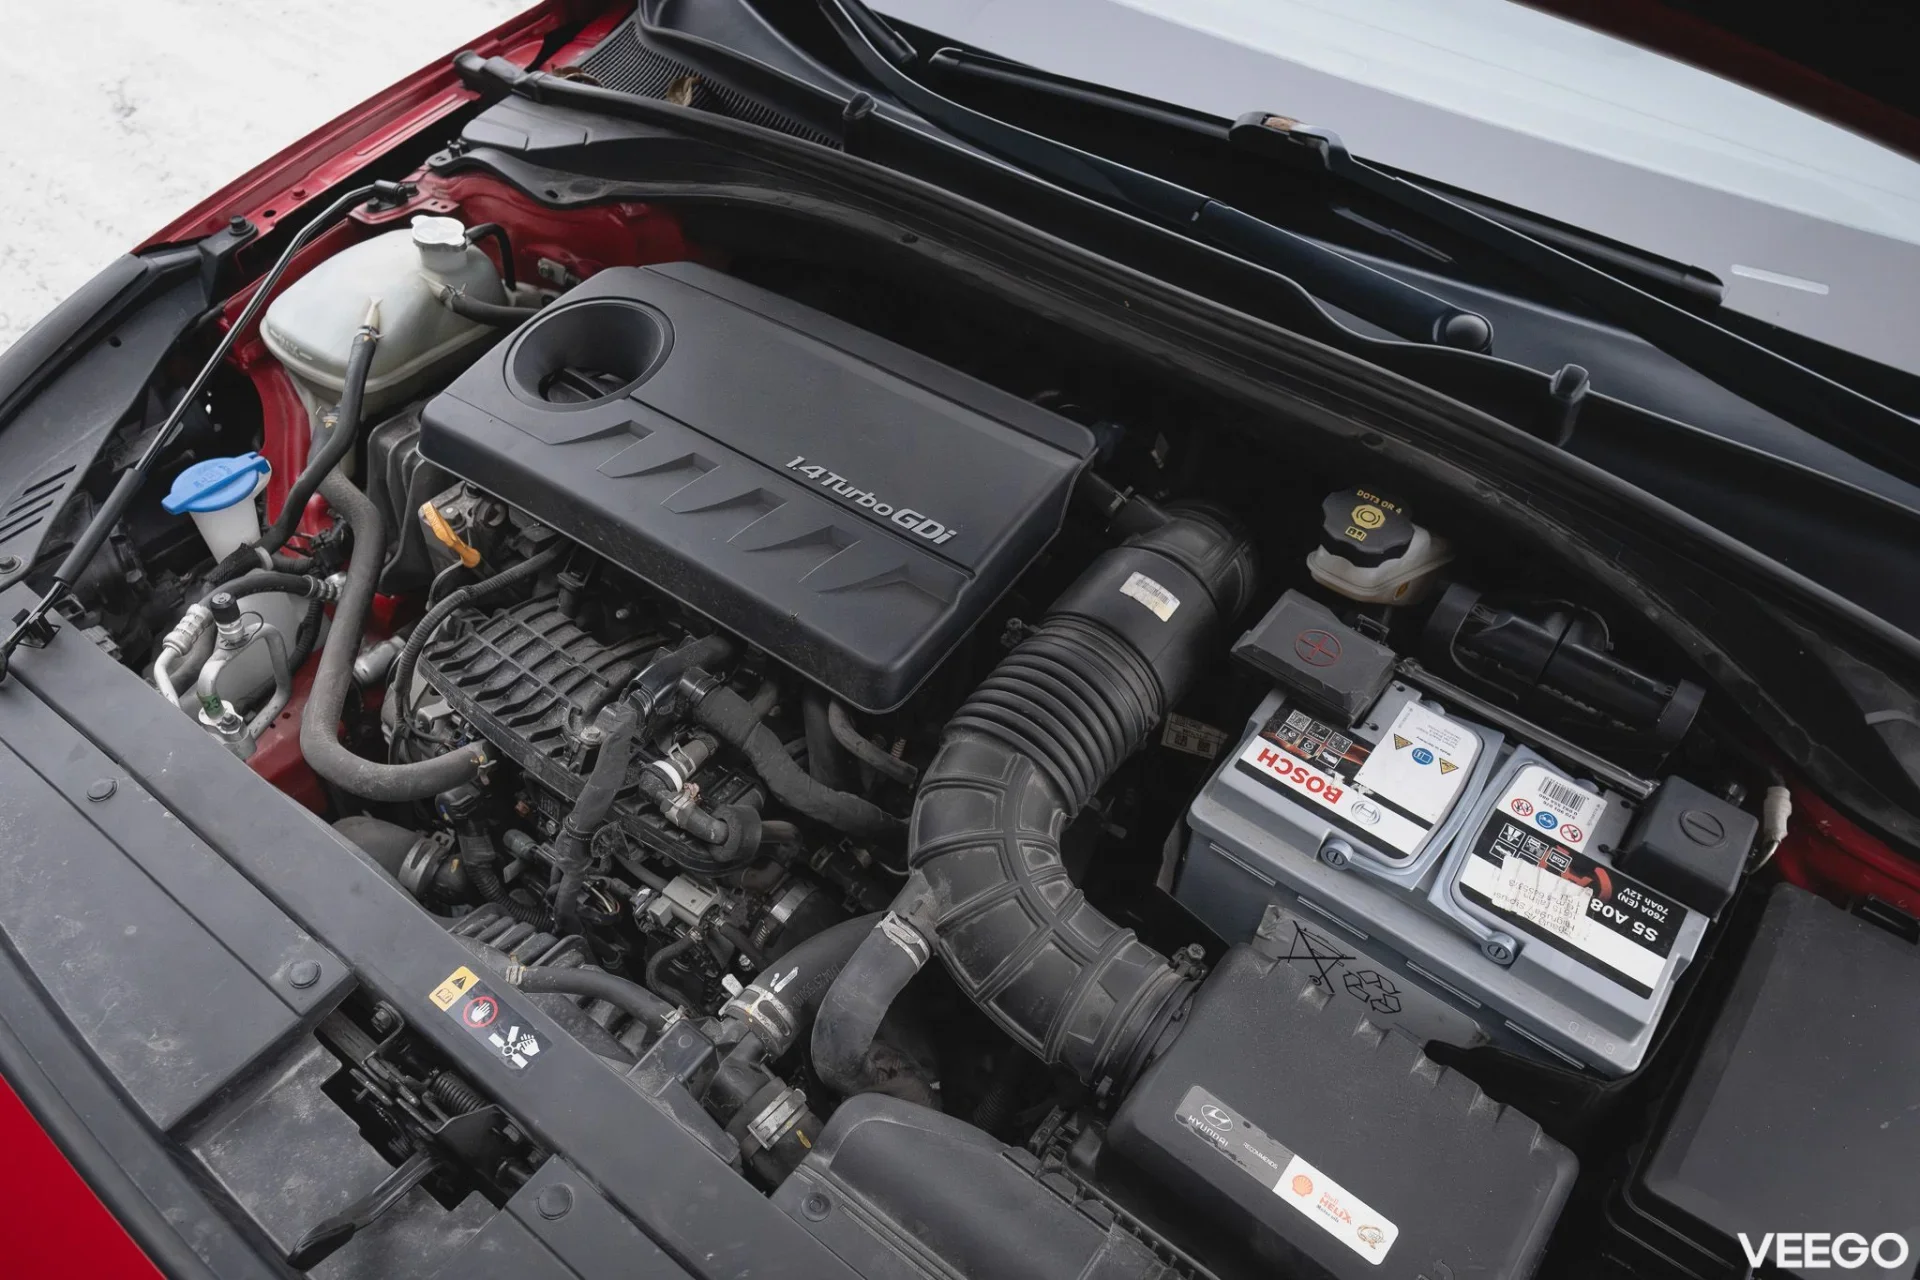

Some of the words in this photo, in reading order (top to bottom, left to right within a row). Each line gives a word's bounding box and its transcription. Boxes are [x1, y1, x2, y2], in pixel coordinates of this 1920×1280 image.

[1356, 489, 1381, 504] DOT3
[1381, 499, 1395, 511] OR
[1395, 507, 1403, 515] 4
[1257, 747, 1344, 804] BOSCH
[1617, 892, 1639, 909] (EN)
[1623, 887, 1643, 900] 12V
[1644, 897, 1669, 915] 70Ah
[1590, 897, 1630, 925] A08
[1641, 905, 1666, 923] 760A
[1631, 921, 1659, 942] S5
[1188, 1114, 1228, 1147] HYUNDAI
[1243, 1141, 1278, 1170] RECOMMENDS
[1319, 1196, 1351, 1224] HELIX
